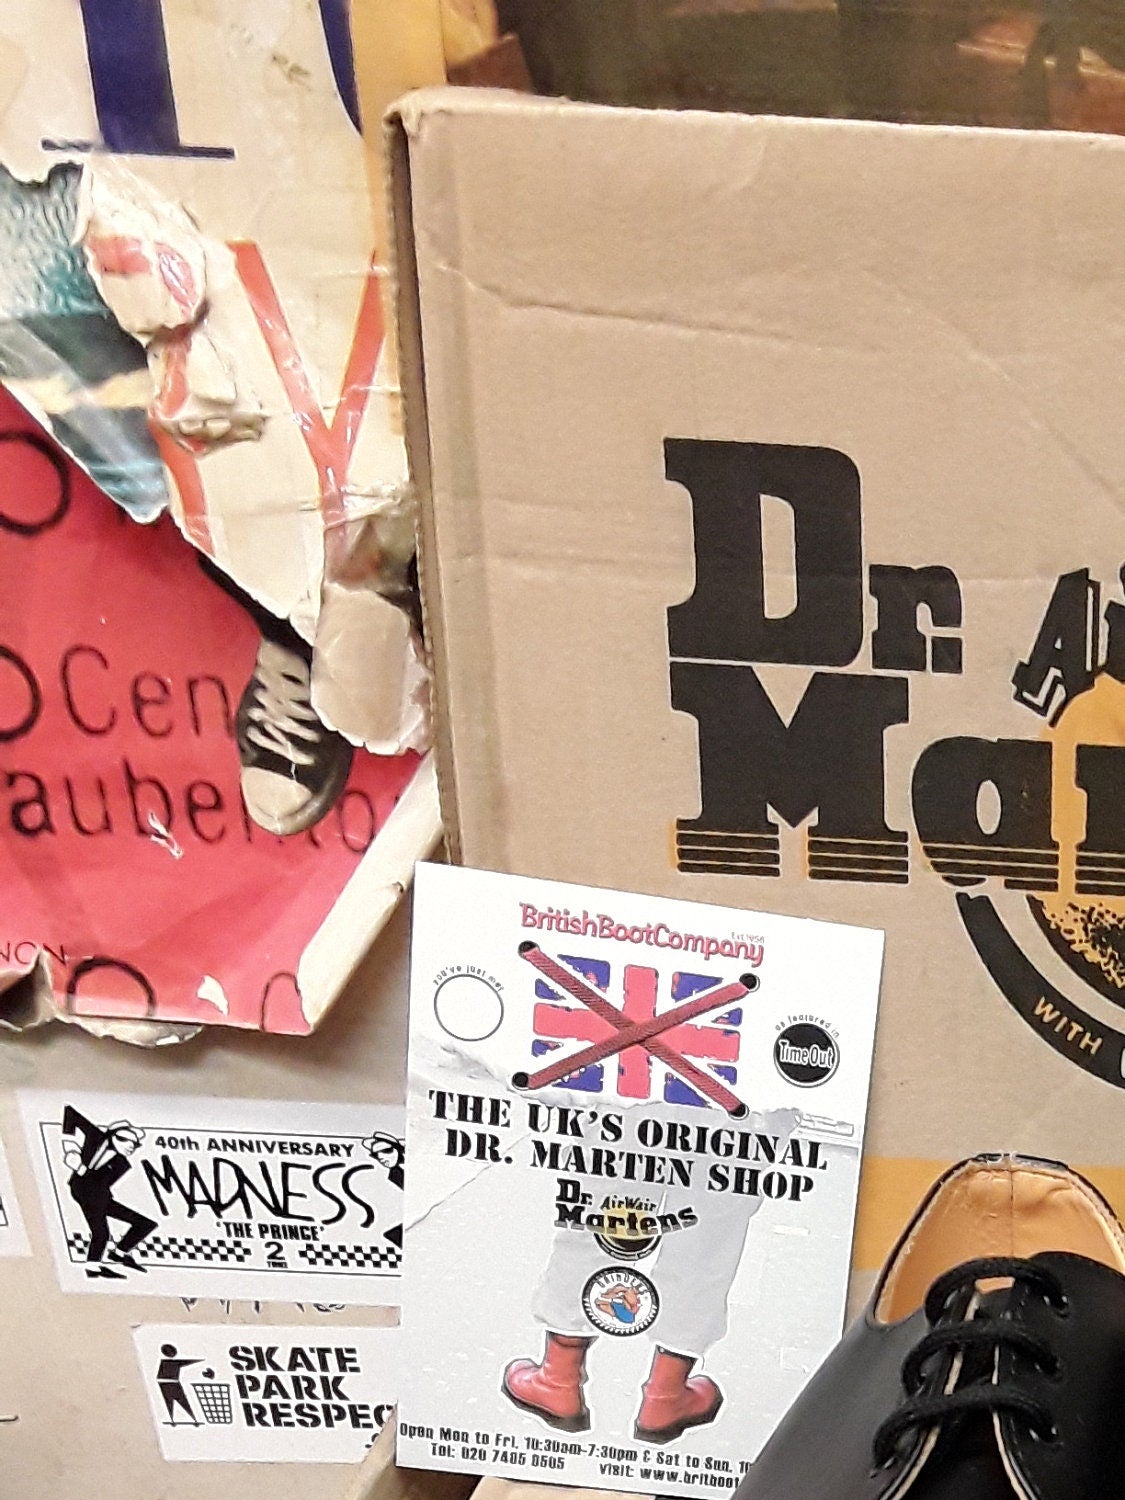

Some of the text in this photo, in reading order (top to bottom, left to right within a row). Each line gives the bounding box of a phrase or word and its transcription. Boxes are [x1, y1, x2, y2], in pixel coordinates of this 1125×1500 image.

[663, 437, 964, 674] Dr.
[1035, 996, 1103, 1056] WITH
[155, 1136, 354, 1158] 40th ANNIVERSARY
[428, 1089, 828, 1172] THE UK'S ORIGINAL
[445, 1128, 814, 1202] DR. MARTEN SHOP
[141, 1154, 375, 1229] MADNESS
[556, 1178, 593, 1206] Dr.
[554, 1203, 699, 1237] Martens
[264, 1241, 286, 1260] 2
[228, 1345, 361, 1373] SKATE
[234, 1374, 351, 1401] PARK
[399, 1422, 434, 1440] Open
[439, 1427, 469, 1444] Mon
[475, 1431, 490, 1445] to
[656, 1451, 680, 1467] Sat
[686, 1455, 700, 1469] to
[461, 1446, 487, 1461] 020
